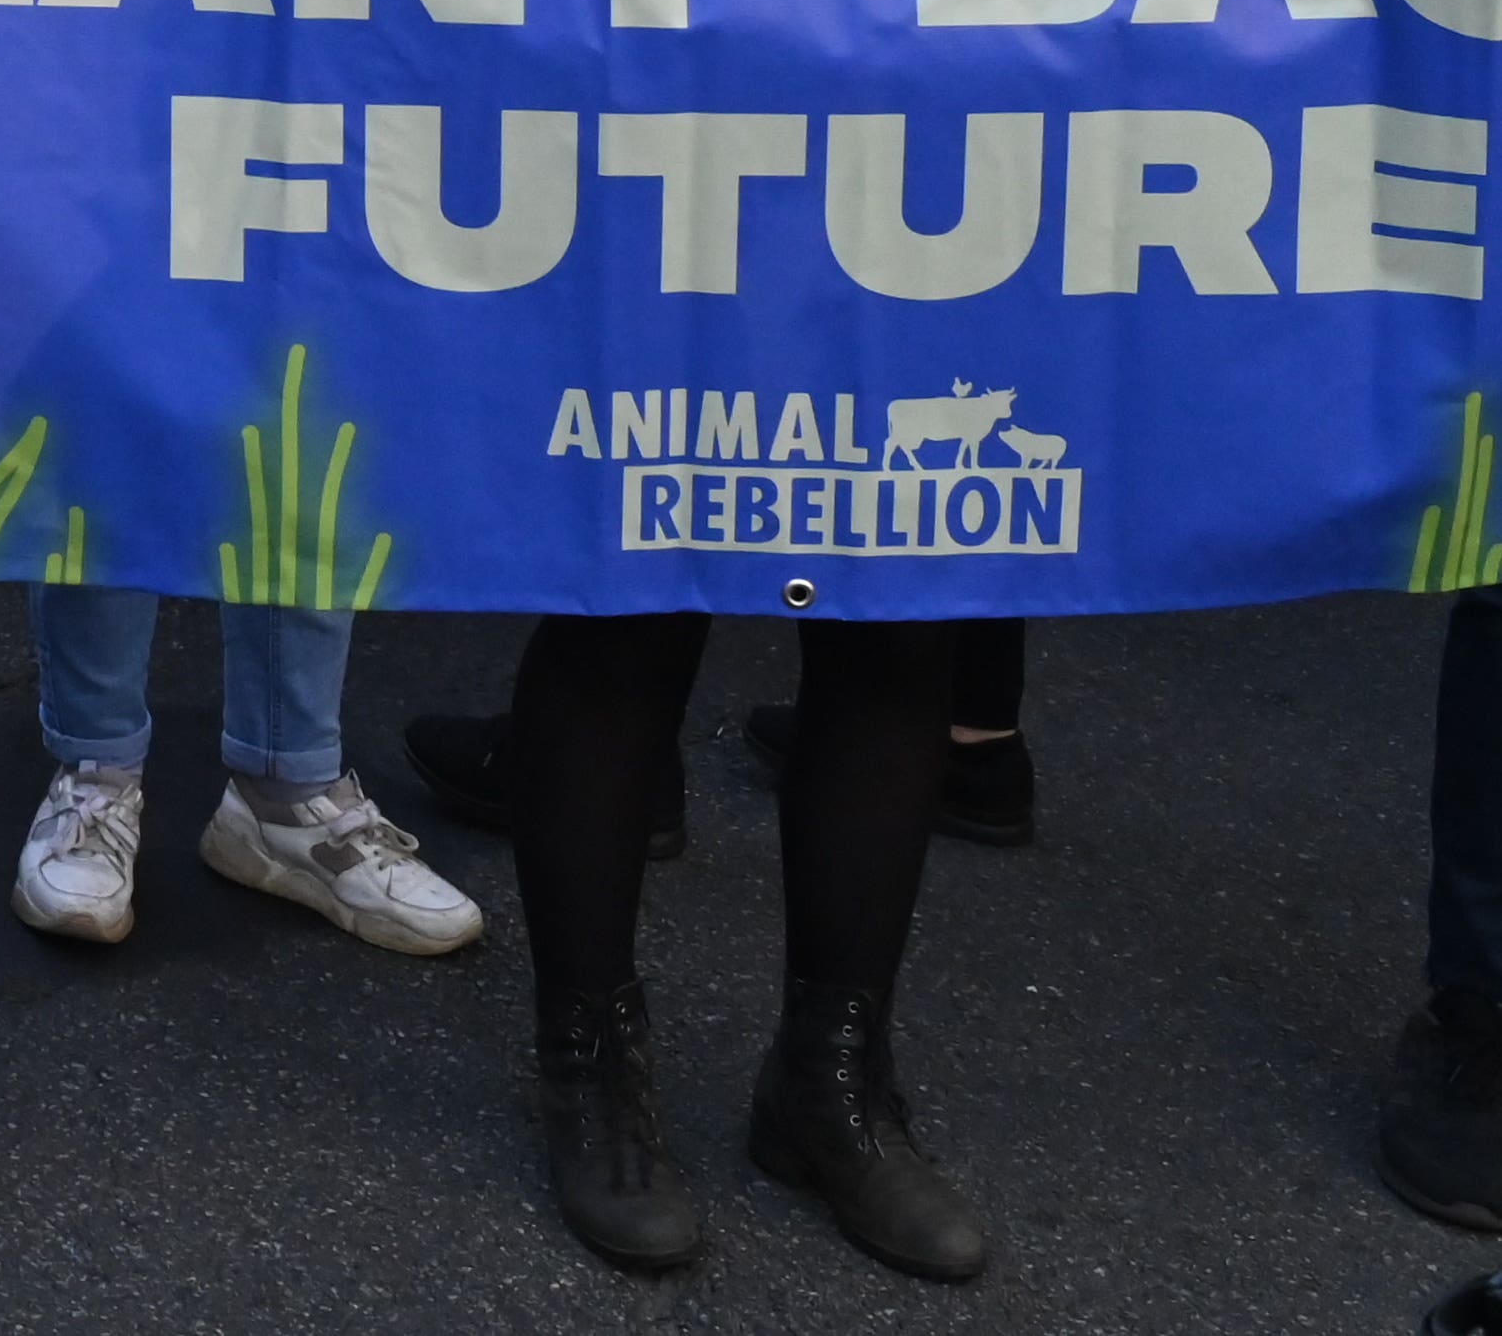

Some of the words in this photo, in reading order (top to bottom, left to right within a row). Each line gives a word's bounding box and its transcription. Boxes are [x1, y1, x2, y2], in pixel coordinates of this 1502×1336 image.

[170, 94, 1489, 301] FUTURE
[547, 388, 869, 461] ANIMAL
[641, 473, 1066, 549] REBELLION
